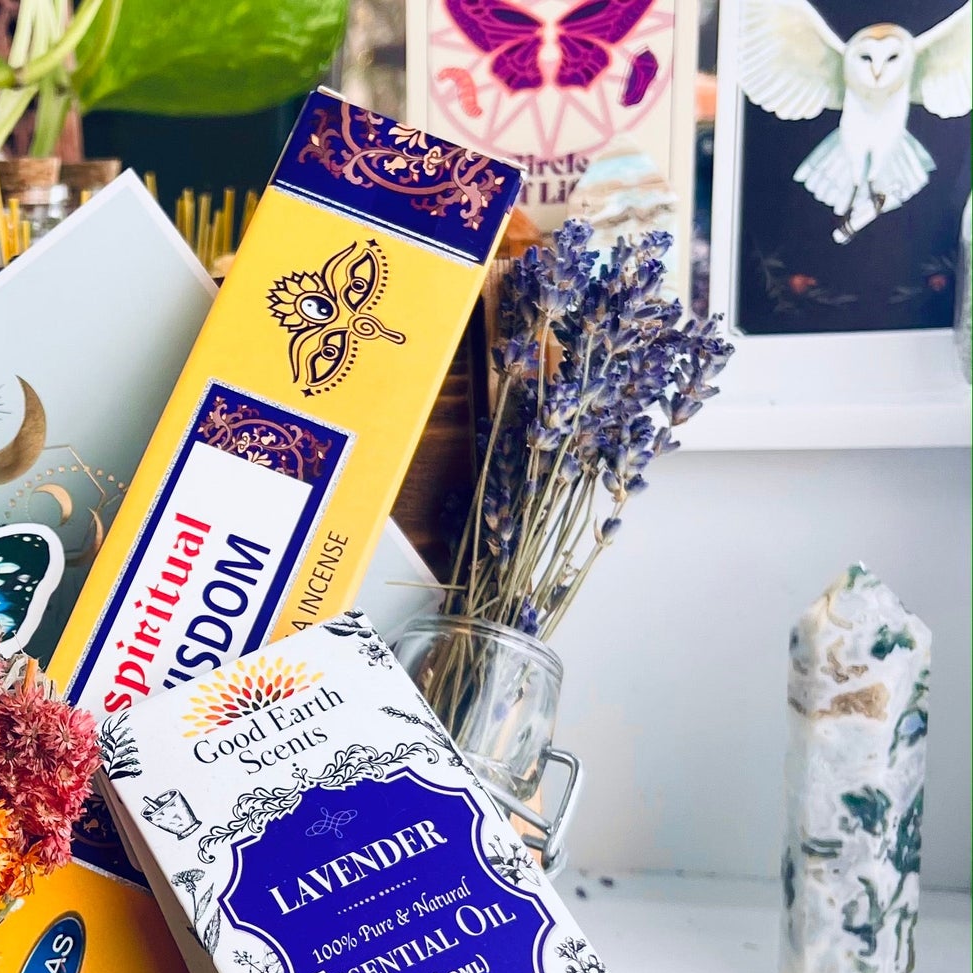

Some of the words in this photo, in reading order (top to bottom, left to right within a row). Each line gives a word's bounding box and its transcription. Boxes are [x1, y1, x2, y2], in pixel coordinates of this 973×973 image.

[514, 153, 589, 175] ircle
[104, 512, 211, 712] spiritual
[298, 531, 348, 615] INCENSE
[193, 722, 267, 764] Good
[270, 686, 345, 731] Earth
[238, 726, 328, 775] Scents
[268, 819, 447, 915] LAVENDER
[312, 934, 358, 964] 100%
[358, 917, 394, 944] Pure
[396, 907, 411, 925] &
[413, 876, 472, 920] Natural
[455, 901, 517, 936] OIL
